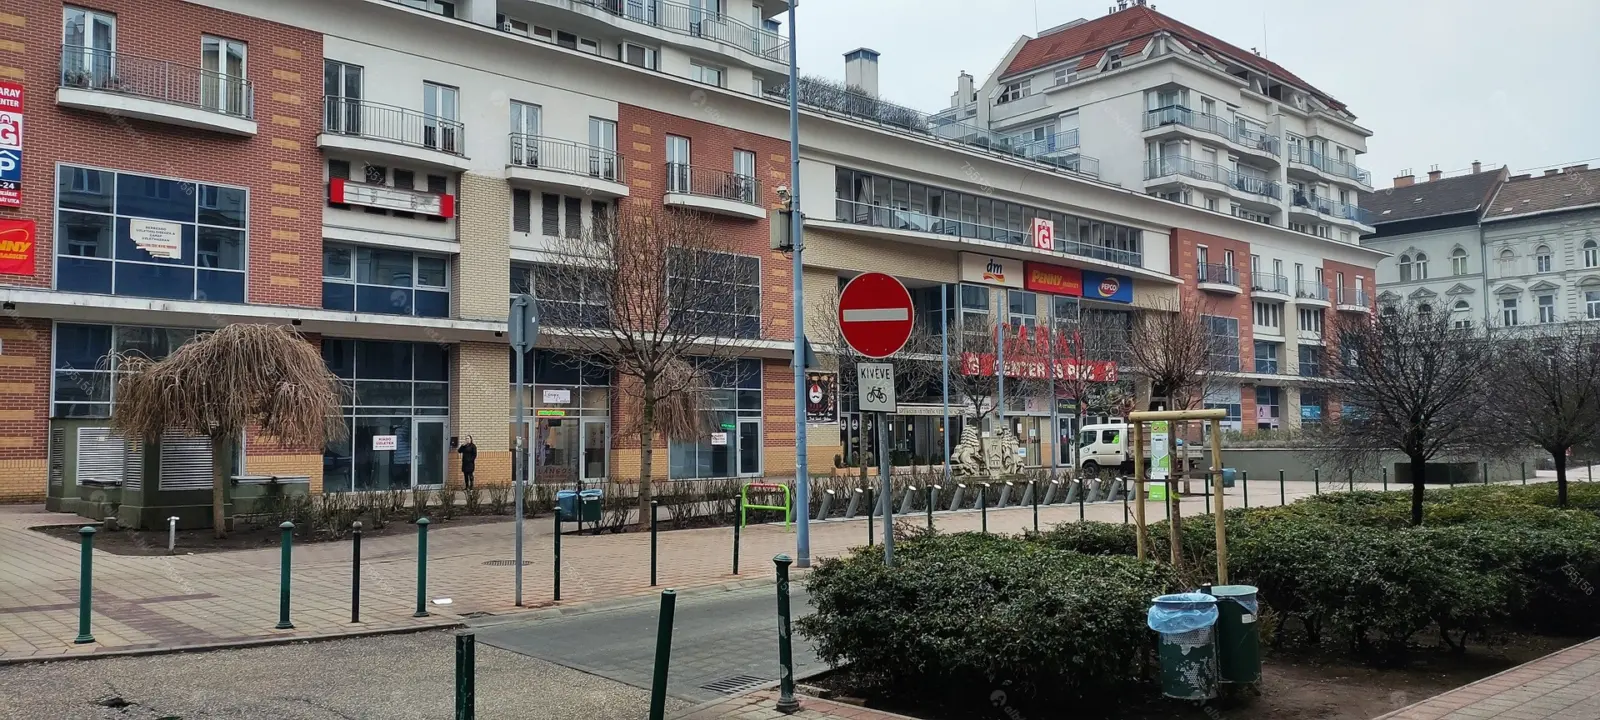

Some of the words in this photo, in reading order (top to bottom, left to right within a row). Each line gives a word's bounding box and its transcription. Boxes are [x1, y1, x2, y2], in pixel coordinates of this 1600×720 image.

[1039, 229, 1050, 249] G
[986, 259, 1003, 274] dm
[1032, 270, 1063, 286] PENNY
[1101, 282, 1117, 292] PEPCO
[861, 365, 891, 380] KIVÉVE
